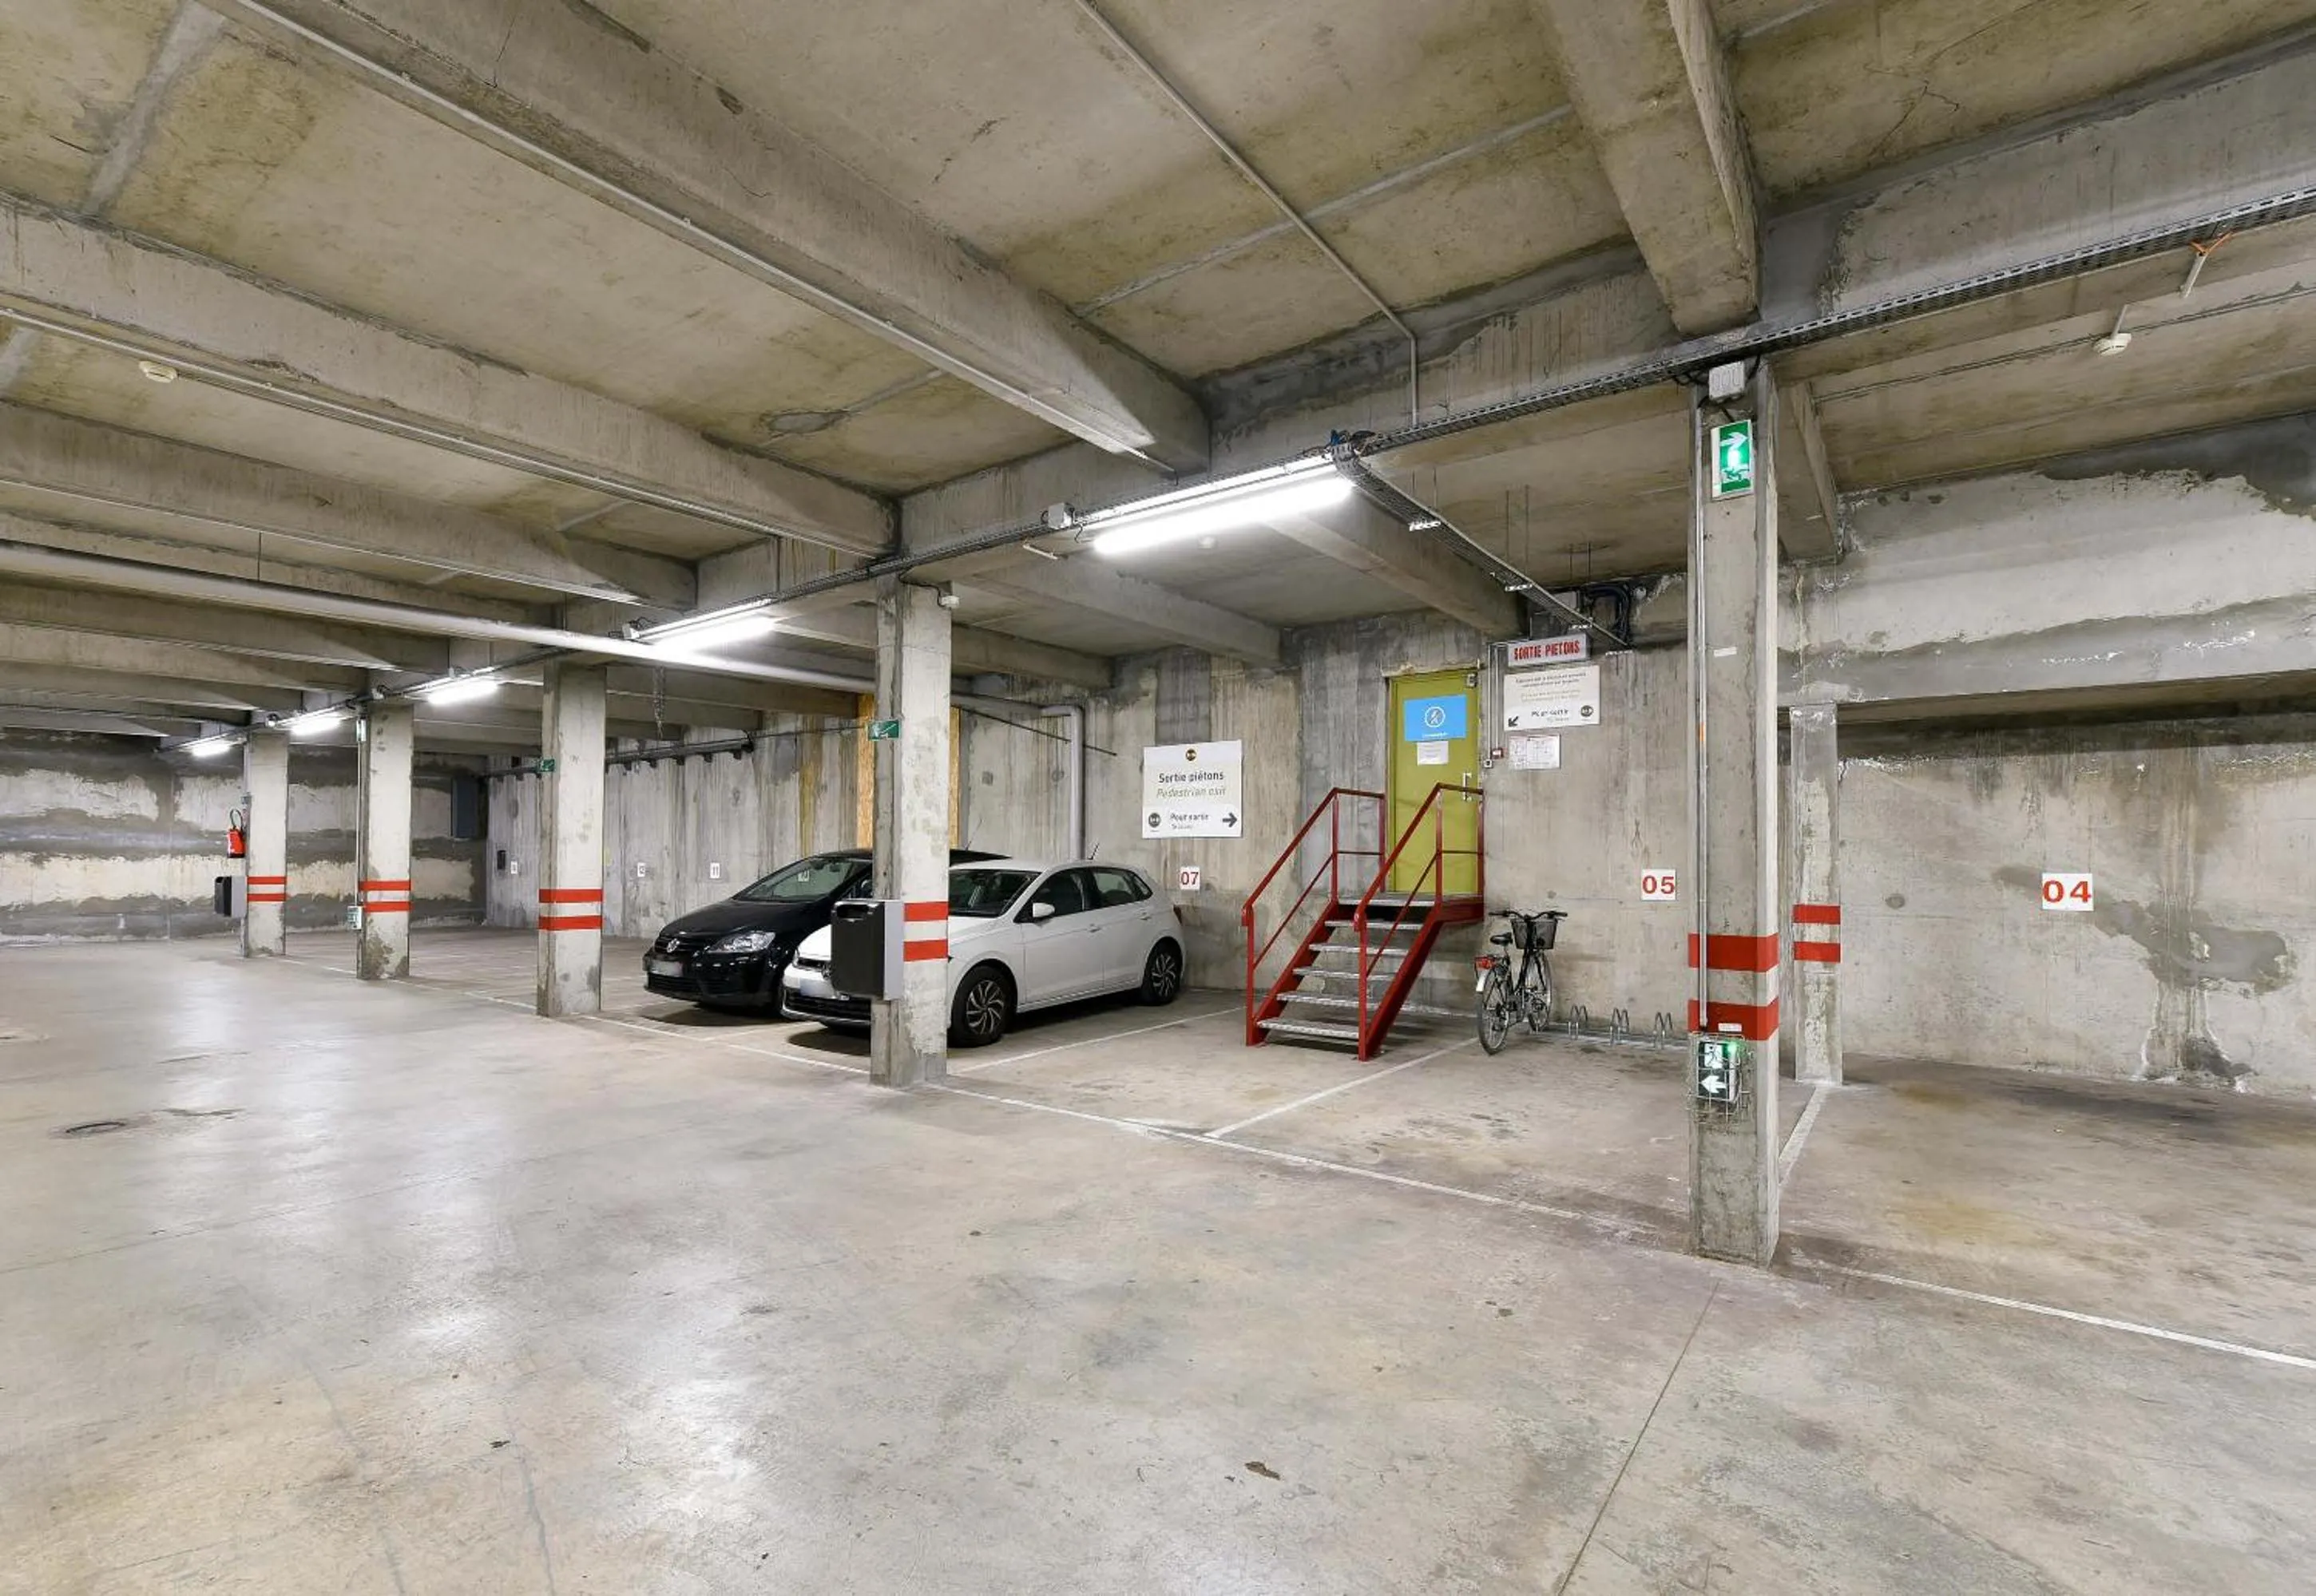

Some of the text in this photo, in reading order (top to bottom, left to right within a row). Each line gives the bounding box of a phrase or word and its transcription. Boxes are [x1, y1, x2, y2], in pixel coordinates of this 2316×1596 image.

[1514, 640, 1580, 660] SORTIE PIETONS
[1159, 770, 1224, 783] Sortie piétons
[1156, 786, 1227, 798] Pedestrian exit
[1181, 871, 1199, 885] 07
[1642, 875, 1675, 894] 05
[2043, 880, 2092, 903] 04
